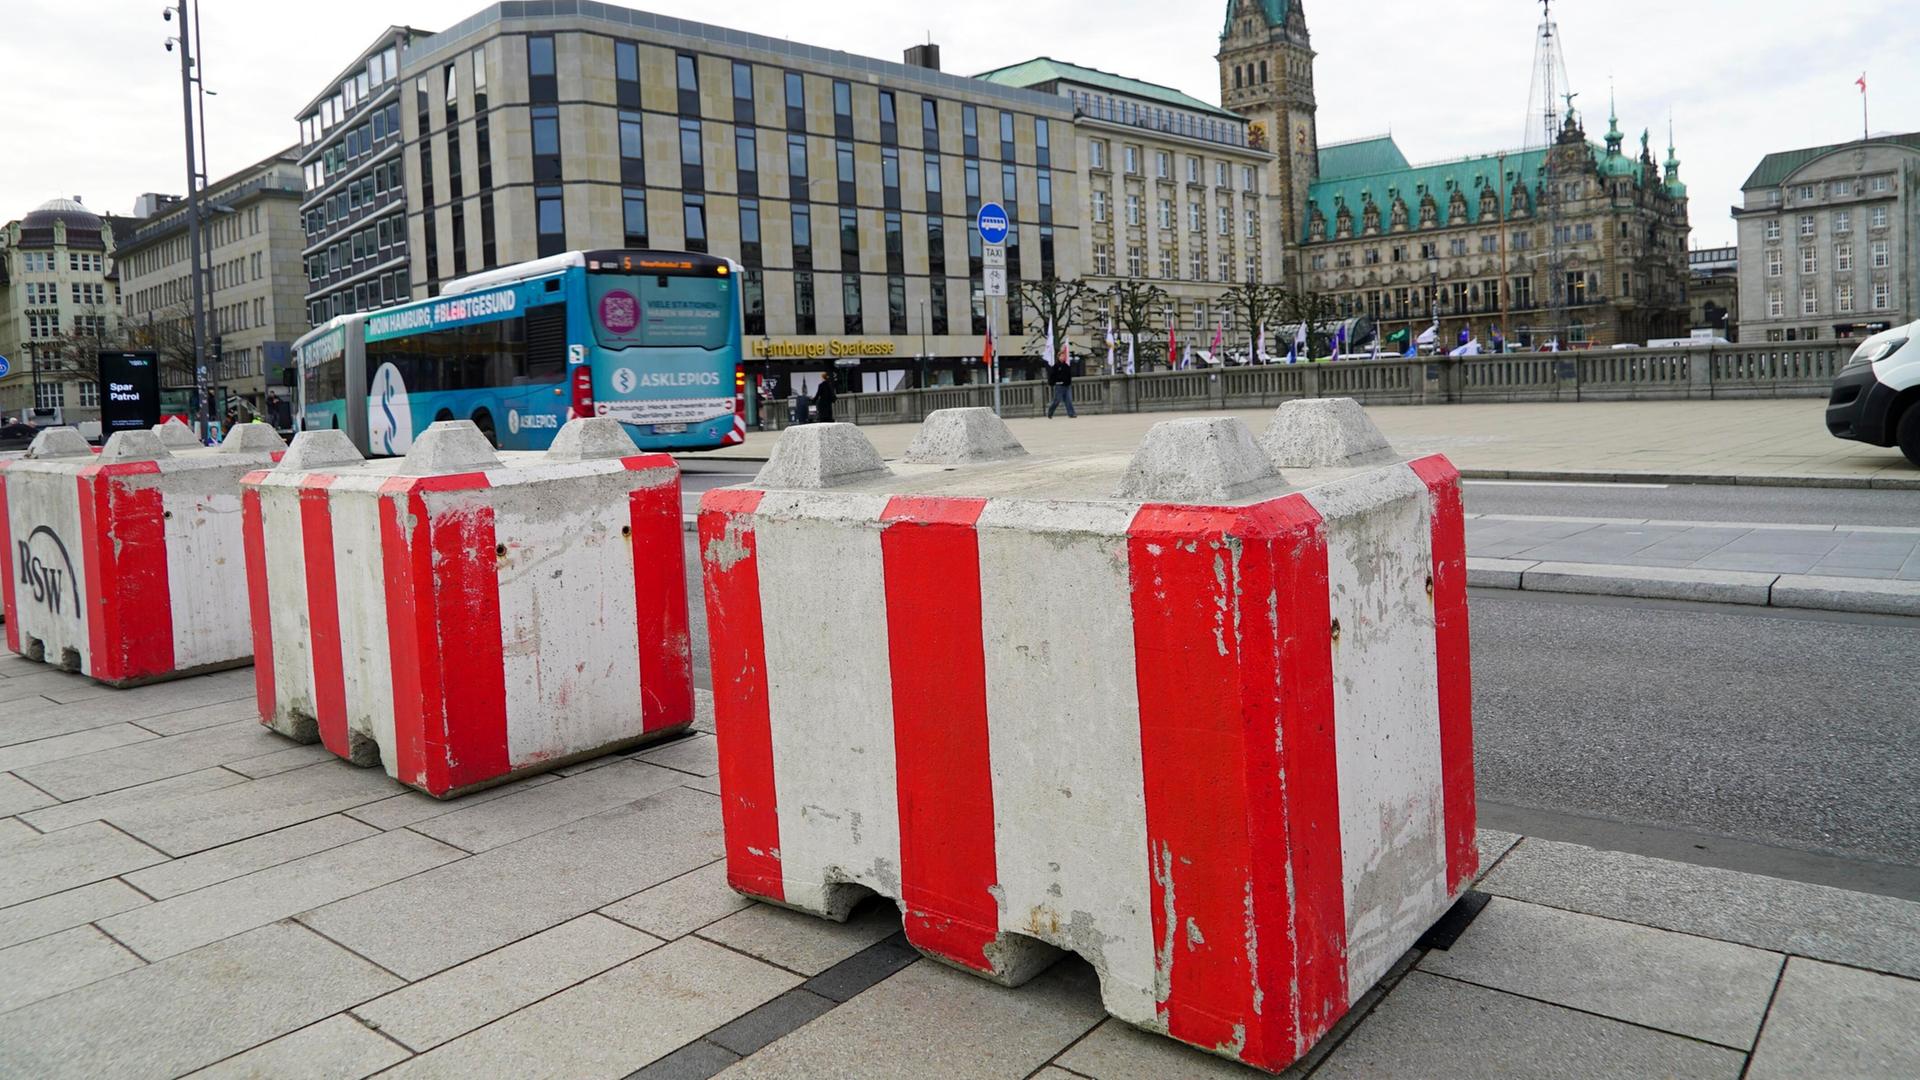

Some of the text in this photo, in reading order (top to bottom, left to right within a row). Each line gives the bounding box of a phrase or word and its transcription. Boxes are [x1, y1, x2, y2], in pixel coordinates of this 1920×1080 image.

[986, 247, 1003, 257] TAXI
[624, 256, 632, 270] 5
[24, 308, 59, 316] GALERIE
[370, 290, 516, 335] MOIN HAMBURG, #BLEIBTGESUND
[752, 339, 896, 358] Hamburger Sparkasse
[641, 372, 720, 387] ASKLEPIOS
[109, 382, 134, 392] Spar
[110, 392, 140, 401] Patrol
[520, 414, 557, 428] ASKLEPIOS
[18, 539, 62, 615] RSW
